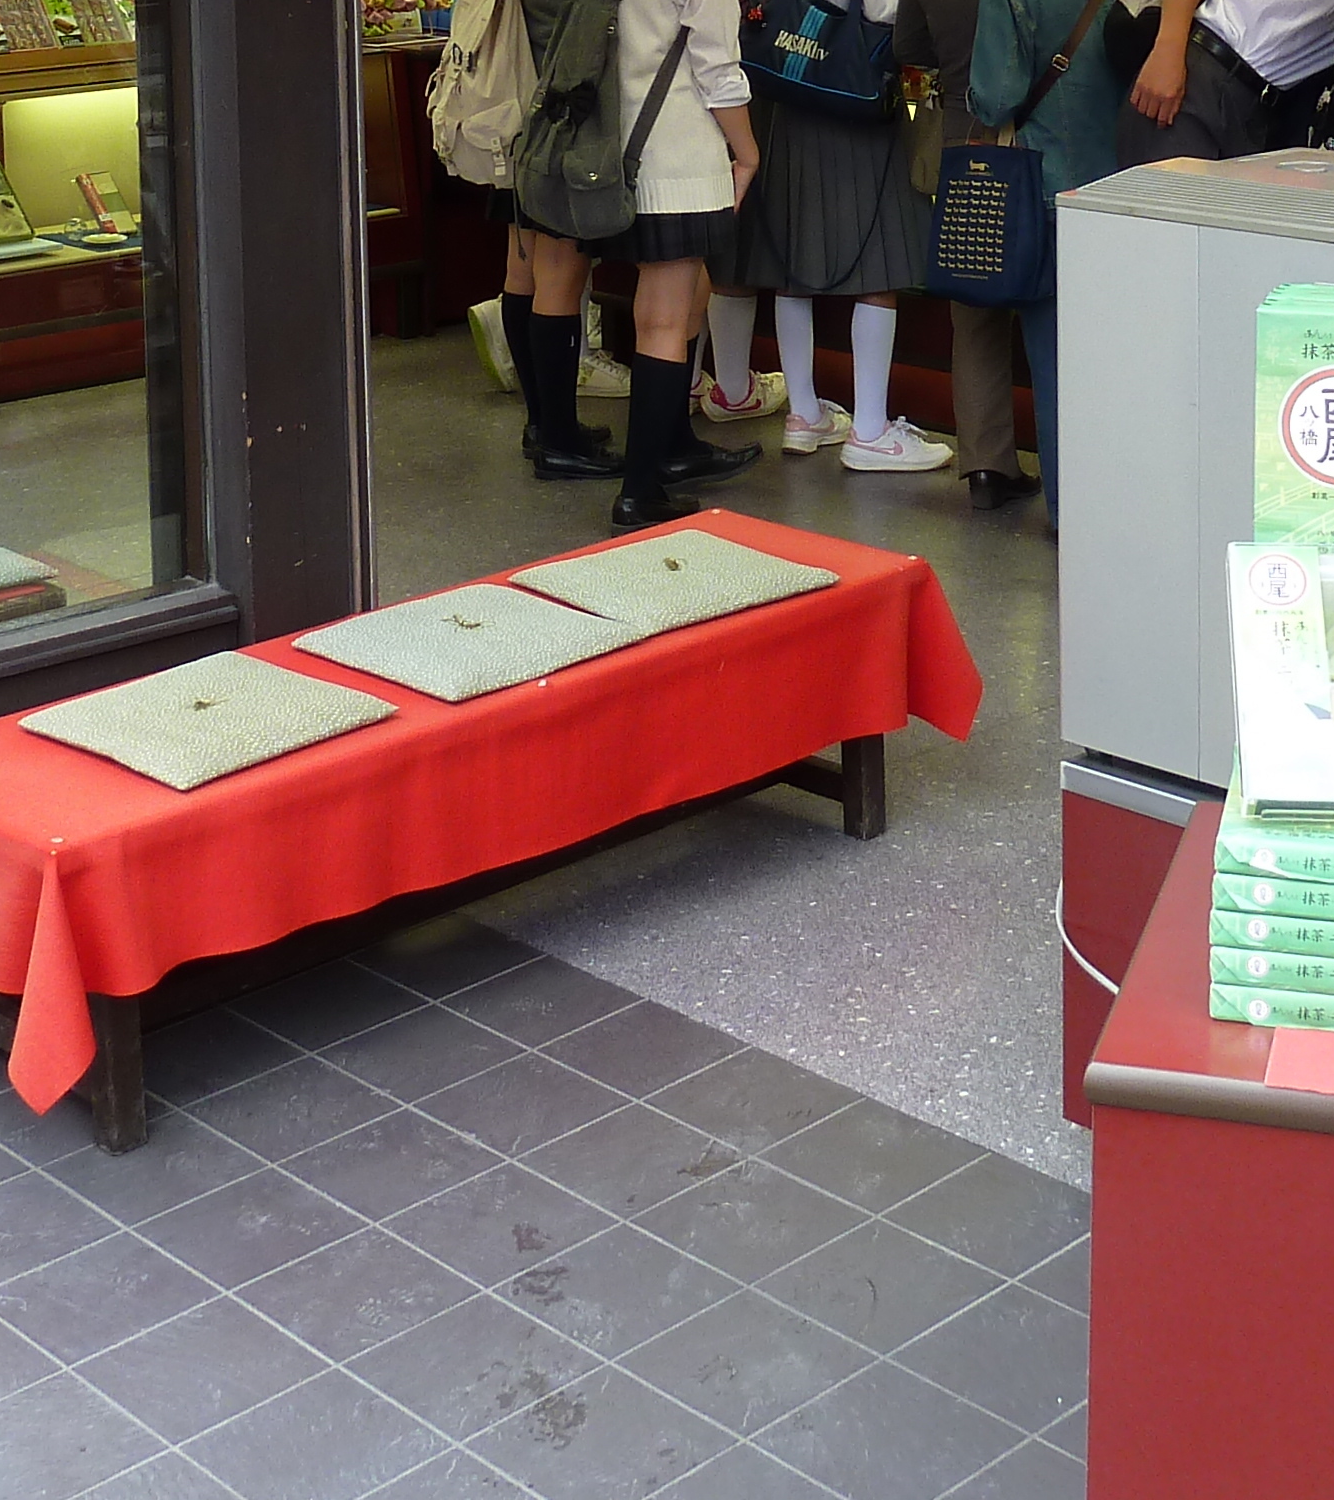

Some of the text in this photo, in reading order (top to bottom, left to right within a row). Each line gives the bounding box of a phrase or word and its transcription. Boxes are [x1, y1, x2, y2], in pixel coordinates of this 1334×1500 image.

[1267, 563, 1290, 598] 西尾
[1302, 856, 1332, 872] 抹茶
[1302, 891, 1330, 906] 抹茶
[1297, 927, 1324, 942] 抹茶
[1296, 963, 1324, 978] 抹茶
[1297, 1006, 1325, 1021] 抹茶
